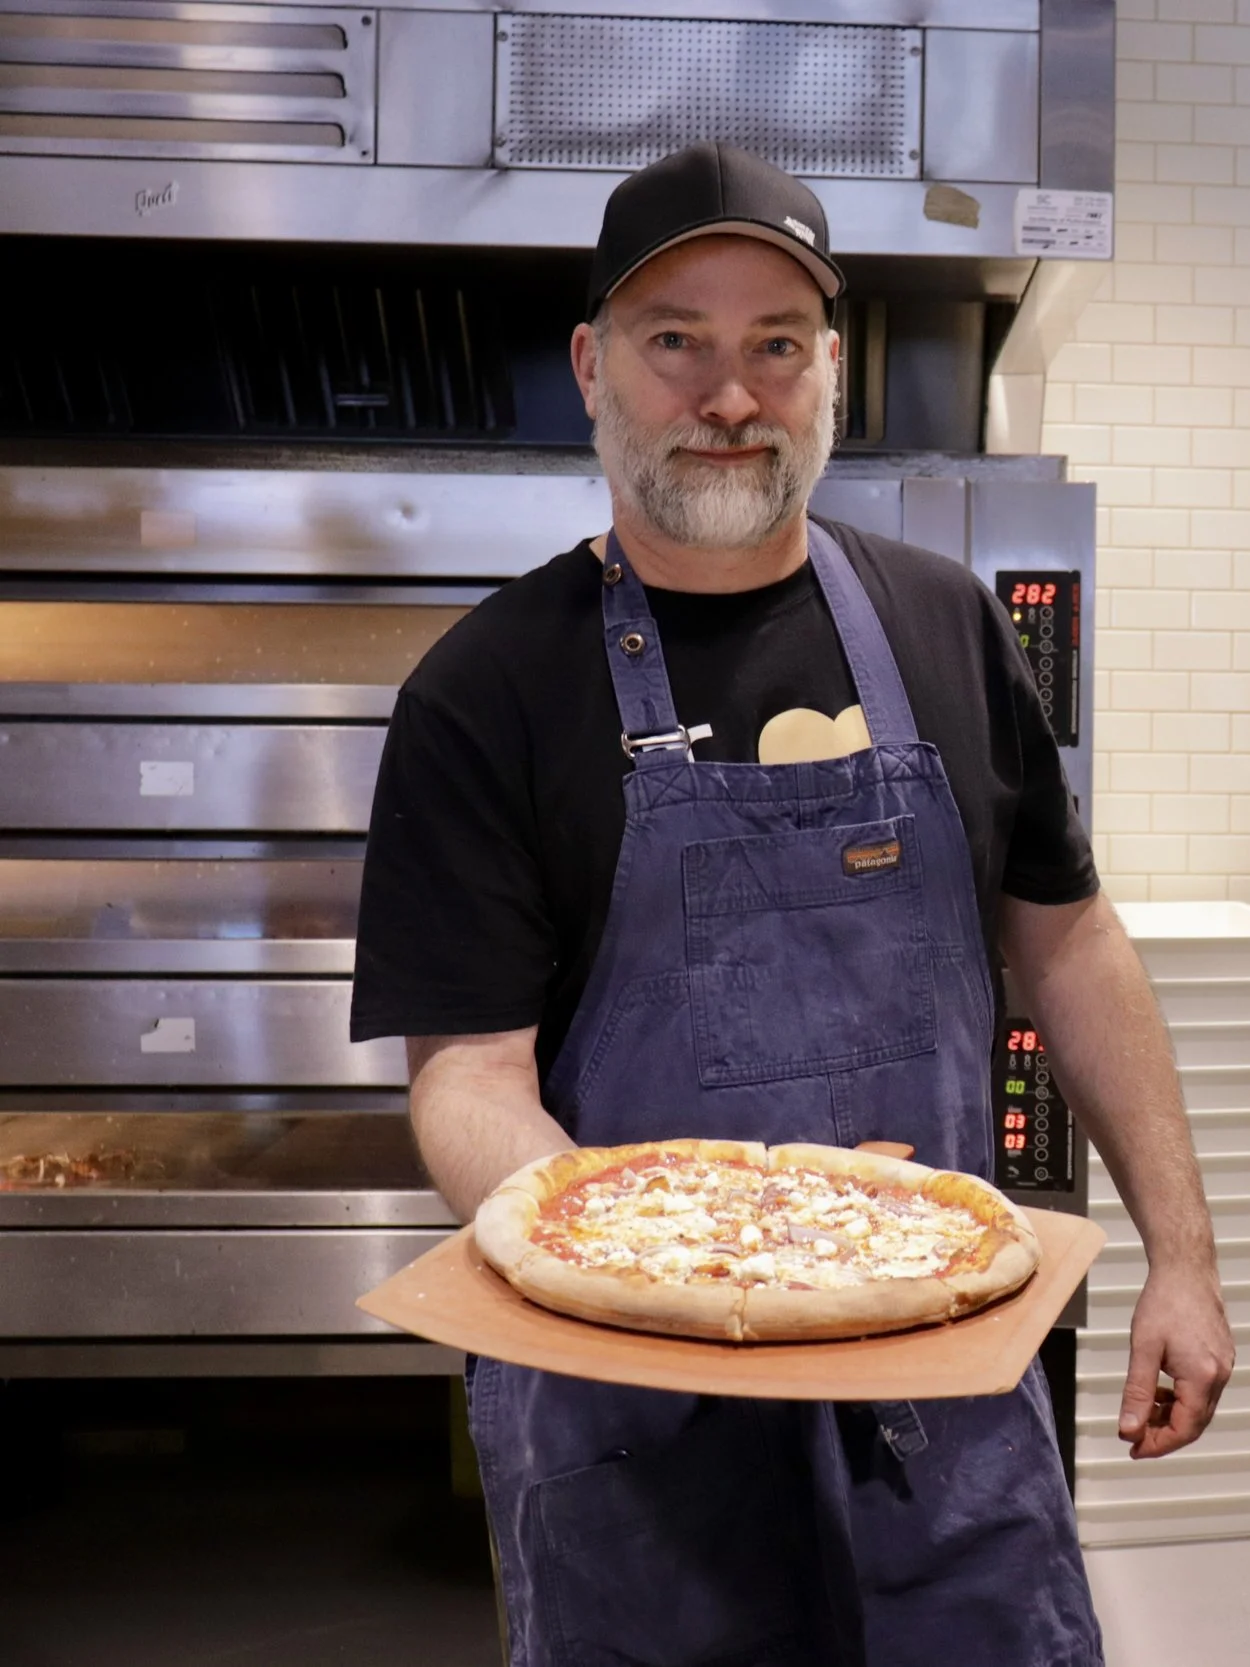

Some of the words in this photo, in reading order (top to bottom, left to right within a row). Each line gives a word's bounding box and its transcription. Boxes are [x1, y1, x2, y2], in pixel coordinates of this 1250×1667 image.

[1011, 583, 1057, 604] 282
[1005, 1080, 1026, 1095] 00
[1004, 1113, 1026, 1130] 03
[1004, 1133, 1026, 1150] 03
